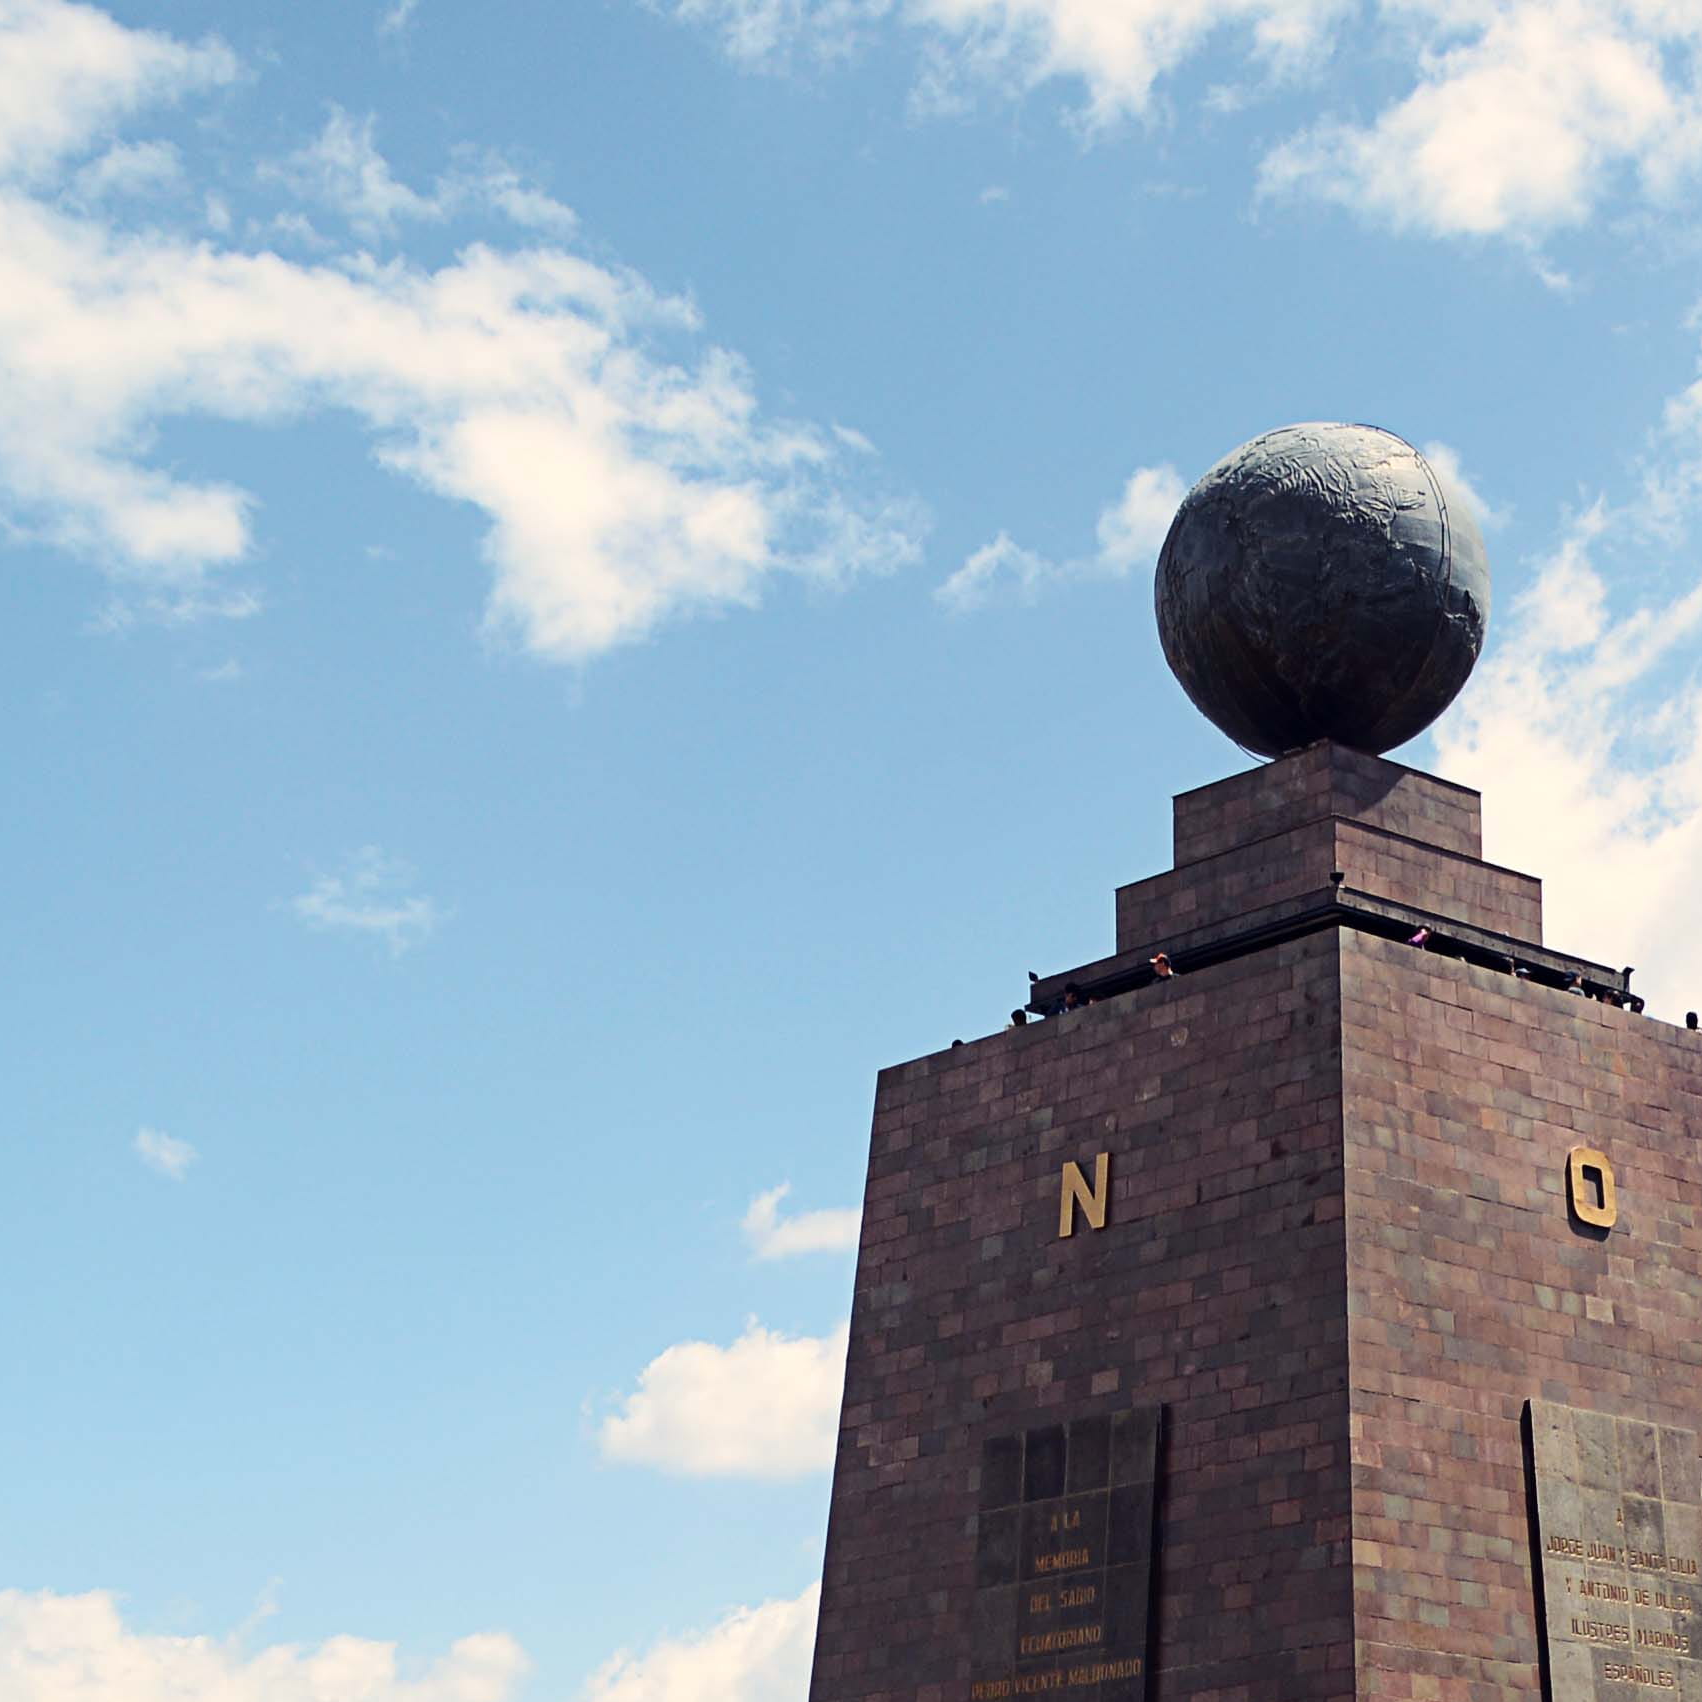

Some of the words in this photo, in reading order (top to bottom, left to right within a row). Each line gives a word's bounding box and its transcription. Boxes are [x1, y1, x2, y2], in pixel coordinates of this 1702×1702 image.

[1058, 1152, 1110, 1238] N
[1566, 1146, 1617, 1228] O
[1063, 1509, 1080, 1530] LA
[1616, 1507, 1624, 1527] A
[1035, 1548, 1090, 1574] MEMORIA
[1547, 1535, 1583, 1557] JORGE
[1587, 1541, 1616, 1562] JUAN
[1630, 1549, 1667, 1572] SANTA
[1669, 1556, 1699, 1577] CILIA
[1030, 1591, 1051, 1615] DEL
[1565, 1577, 1572, 1595] Y
[1579, 1579, 1629, 1604] ANTONIO
[1634, 1588, 1651, 1608] DE
[1655, 1591, 1694, 1615] ULLOA
[1019, 1625, 1101, 1655] ECUATORIANO
[1571, 1618, 1629, 1644] ILUSTRES
[1637, 1627, 1689, 1654] MARINOS
[971, 1680, 1010, 1701] PEDRO
[1014, 1669, 1064, 1695] VICENTE
[1067, 1658, 1142, 1687] MALDONADO
[1604, 1662, 1675, 1689] ESPAÑOLES
